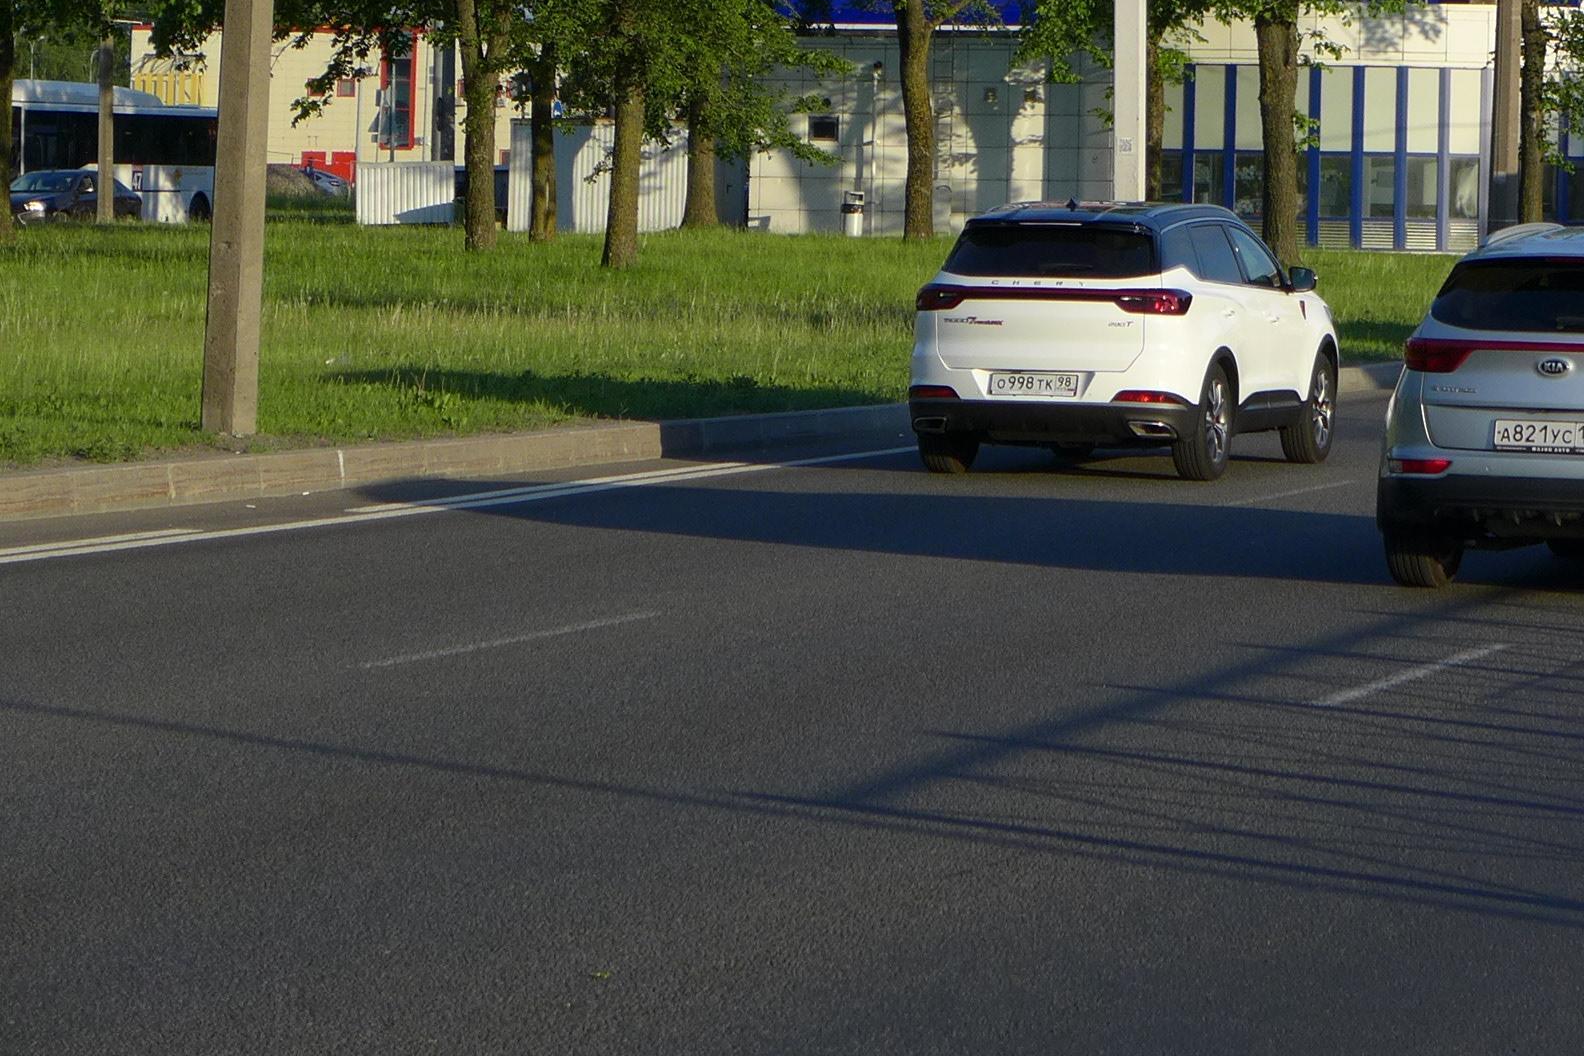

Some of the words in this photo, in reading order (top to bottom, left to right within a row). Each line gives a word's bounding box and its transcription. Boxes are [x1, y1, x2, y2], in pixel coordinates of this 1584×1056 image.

[1544, 362, 1563, 372] KIA
[997, 376, 1053, 391] О998ТК
[1057, 377, 1072, 387] 98
[1500, 424, 1573, 444] А821УС
